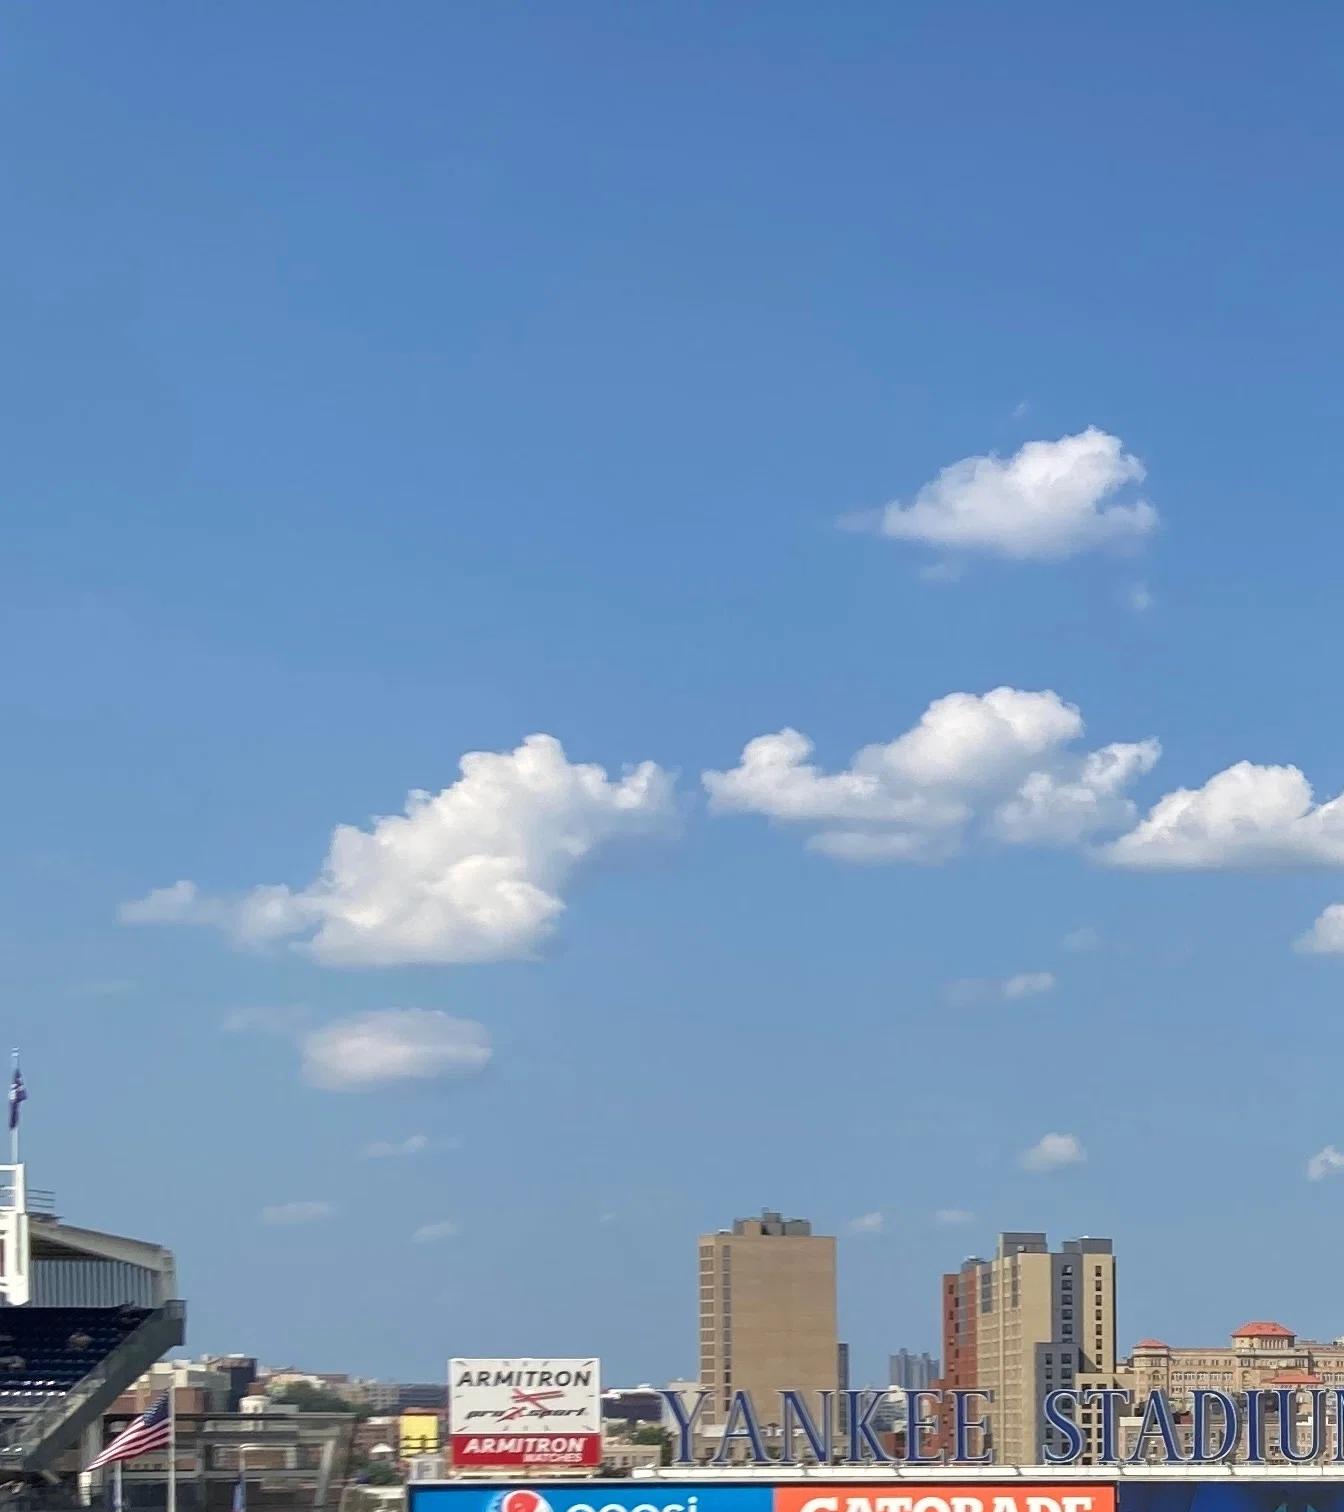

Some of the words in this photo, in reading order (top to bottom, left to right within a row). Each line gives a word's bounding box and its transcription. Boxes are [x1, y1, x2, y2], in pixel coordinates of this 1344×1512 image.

[456, 1371, 591, 1387] ARMITRON
[660, 1389, 995, 1465] YANKEE
[462, 1437, 586, 1454] ARMITRON
